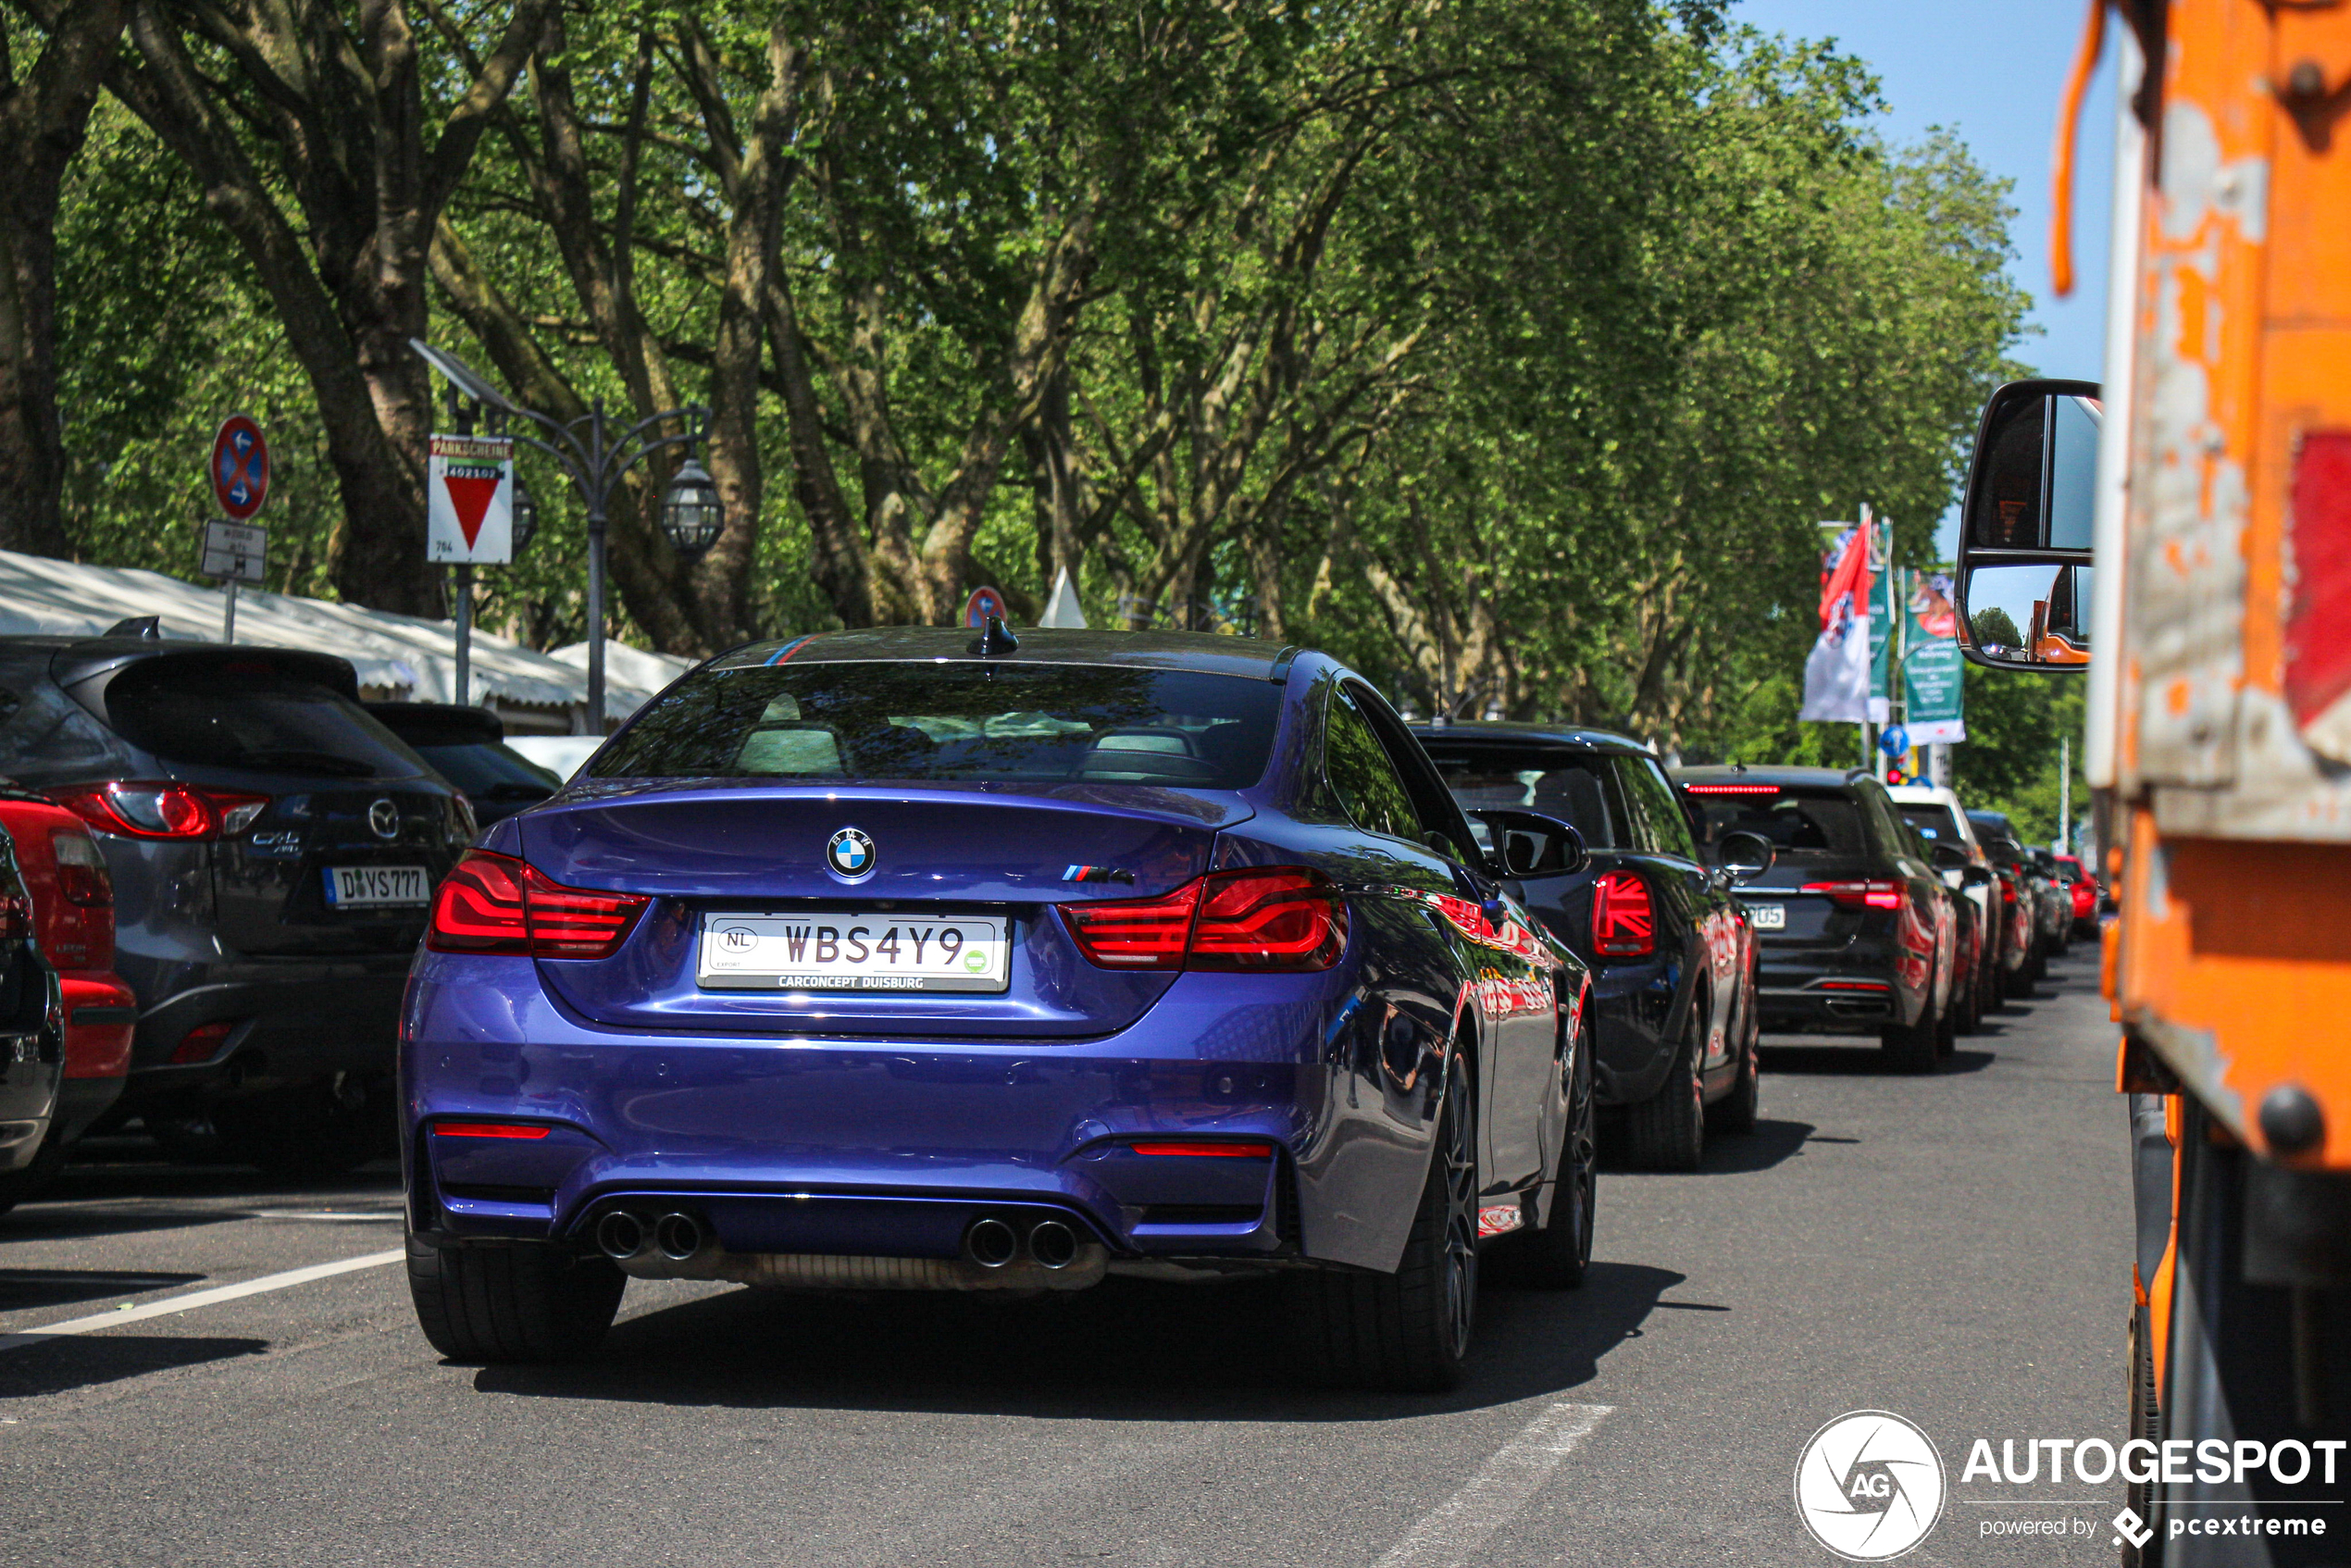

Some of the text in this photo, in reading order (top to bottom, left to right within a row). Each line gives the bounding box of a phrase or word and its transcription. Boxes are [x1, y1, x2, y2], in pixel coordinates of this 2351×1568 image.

[432, 441, 510, 460] PARKSCHEINE
[727, 932, 751, 946] NL
[785, 925, 964, 965] WBS4Y9
[777, 976, 924, 989] CARCONCEPT DUISBURG
